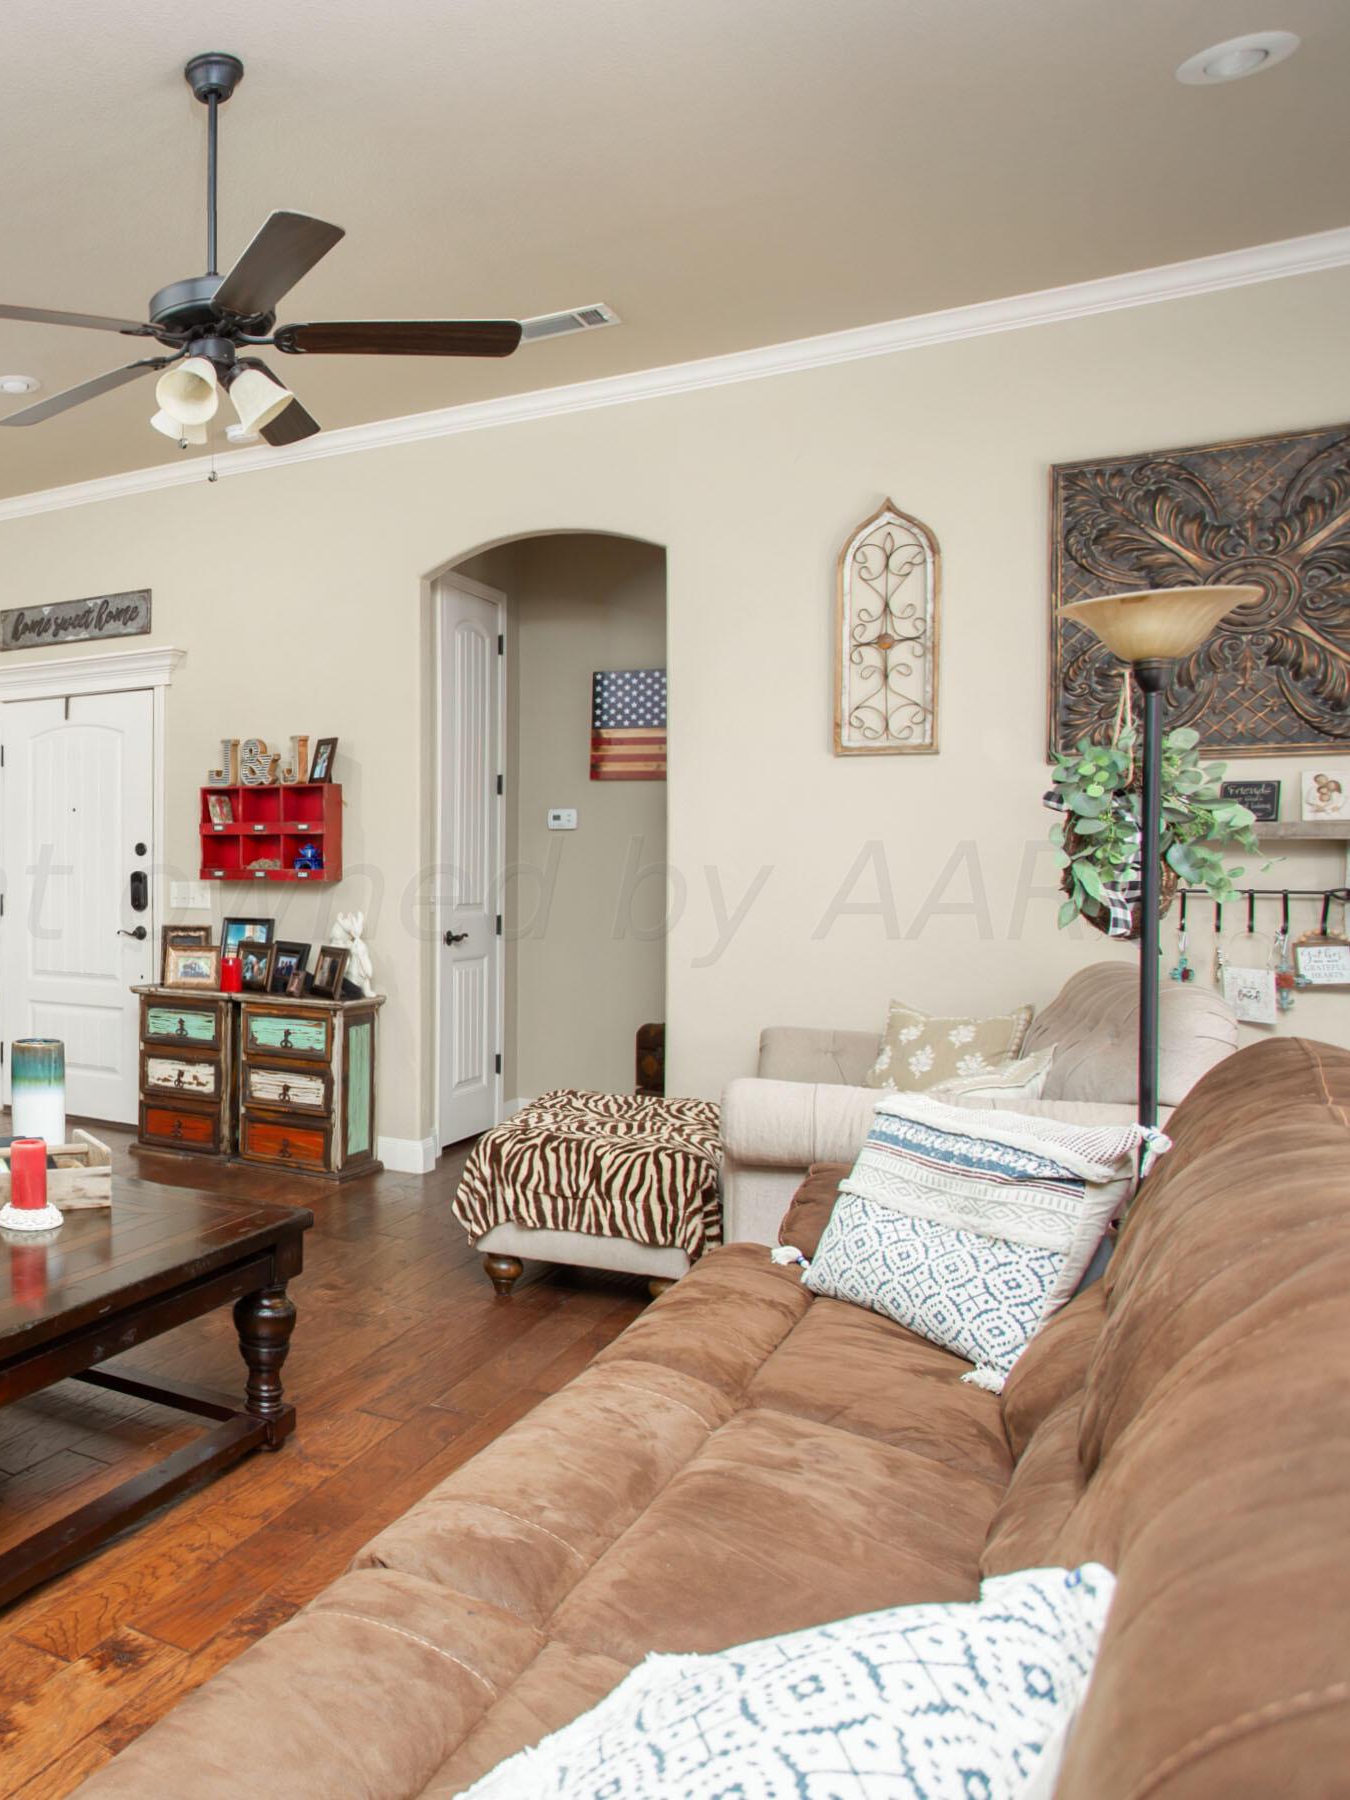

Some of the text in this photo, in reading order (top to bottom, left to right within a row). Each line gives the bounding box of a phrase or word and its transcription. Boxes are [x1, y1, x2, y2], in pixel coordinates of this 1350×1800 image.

[11, 600, 140, 642] home sweet home
[208, 736, 309, 785] J & J
